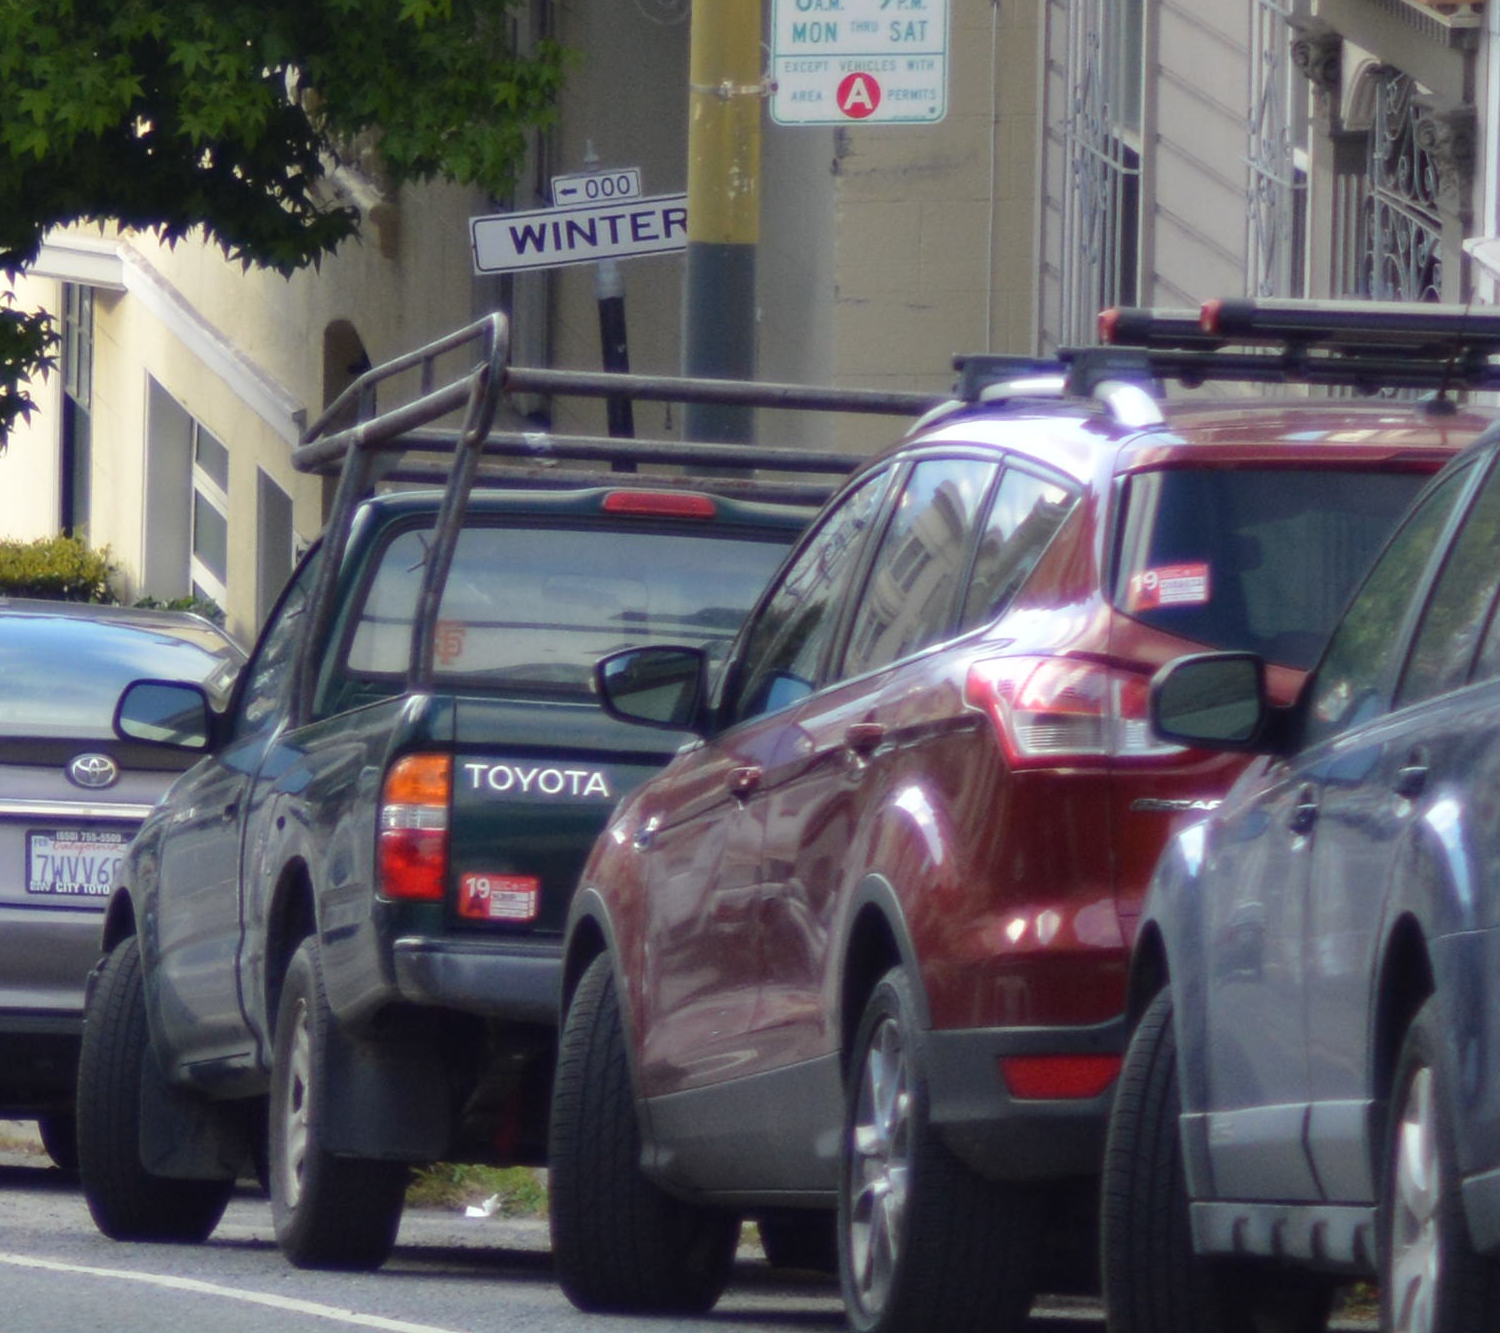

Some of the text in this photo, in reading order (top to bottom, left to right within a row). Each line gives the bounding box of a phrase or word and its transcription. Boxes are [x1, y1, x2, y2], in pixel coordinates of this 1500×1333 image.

[791, 19, 929, 44] MON THRU SAT
[784, 58, 935, 74] EXCEPT VEHICLES WITH
[790, 76, 937, 111] AREA A PERMITS
[584, 174, 631, 199] 000
[509, 207, 688, 255] WINTER
[1131, 571, 1159, 594] 19
[465, 763, 611, 798] TOYOTA
[52, 842, 126, 855] California
[55, 883, 80, 894] CITY
[466, 877, 491, 899] 19
